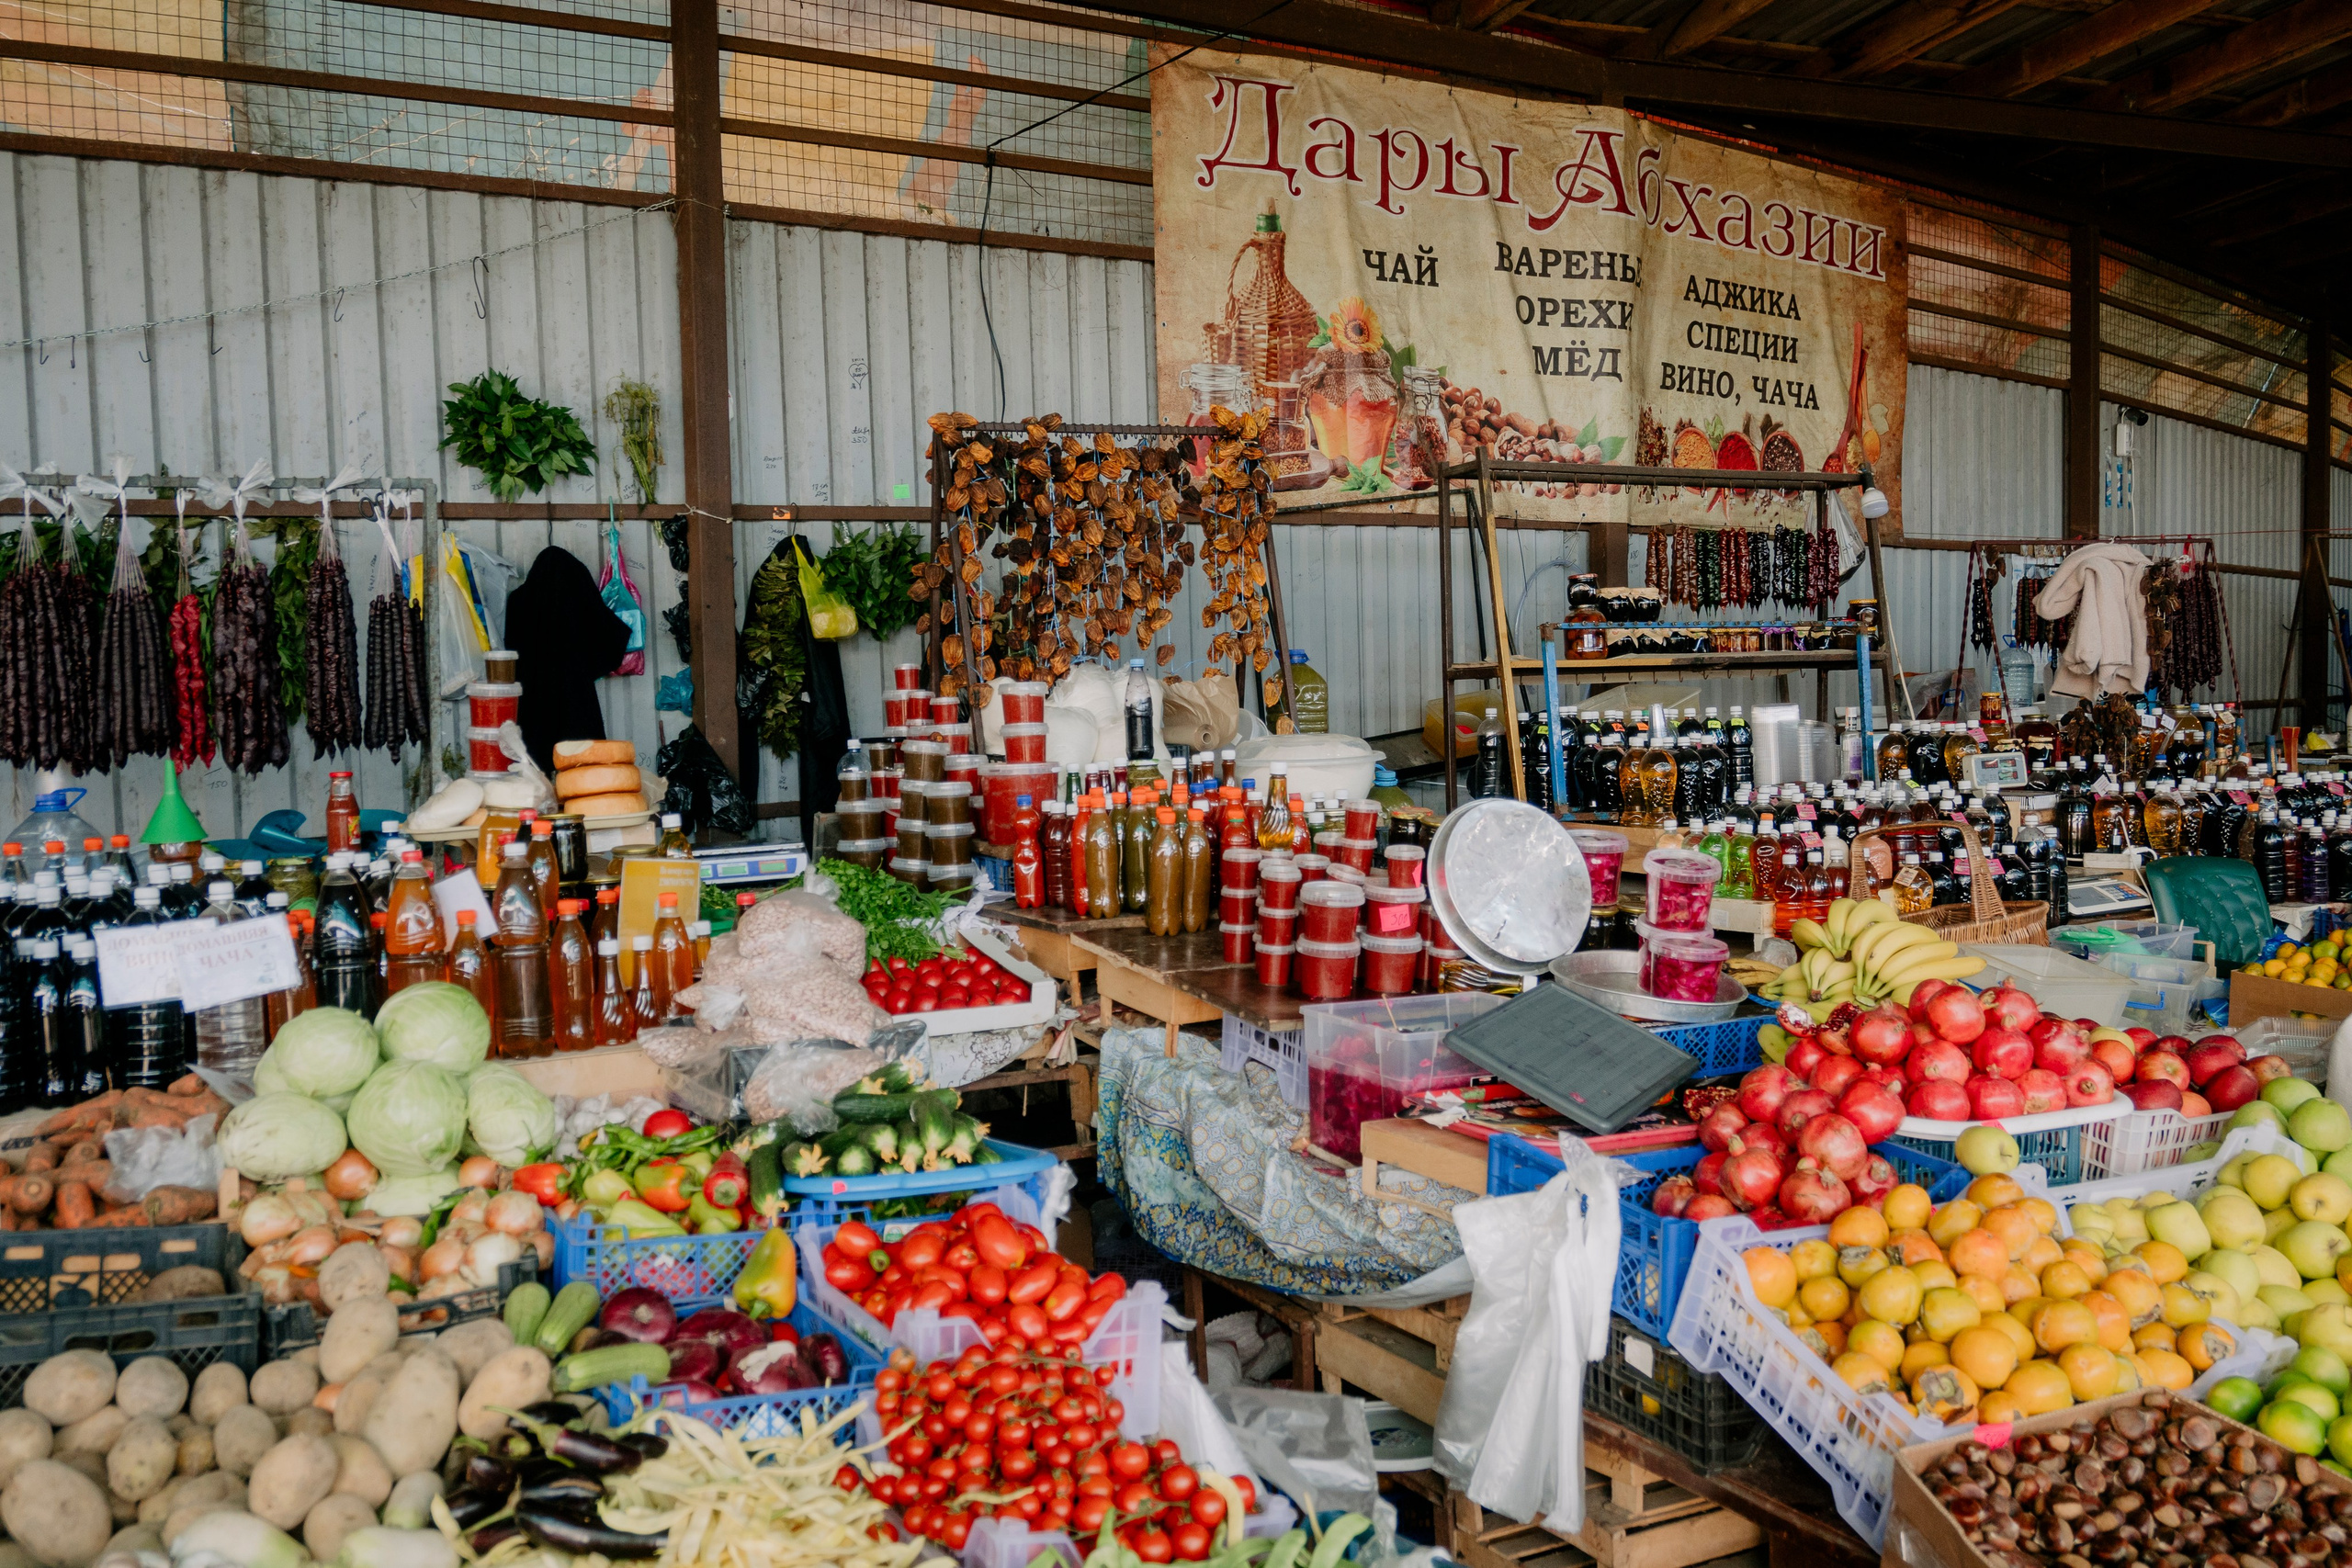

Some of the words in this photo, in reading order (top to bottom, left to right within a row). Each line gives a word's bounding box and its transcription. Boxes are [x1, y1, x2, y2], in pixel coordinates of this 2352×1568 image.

[1197, 75, 1520, 215] Дары
[1528, 130, 1886, 278] Абхазии
[1363, 244, 1440, 288] ЧАЙ
[1515, 295, 1634, 332] ОРЕХИ
[1683, 275, 1802, 321] АДЖИКА
[1532, 340, 1623, 383] МЁД
[1687, 320, 1799, 364] СПЕЦИИ
[1659, 362, 1741, 407] ВИНО,
[1752, 376, 1820, 411] ЧАЧА
[198, 947, 254, 969] ЧАЧА
